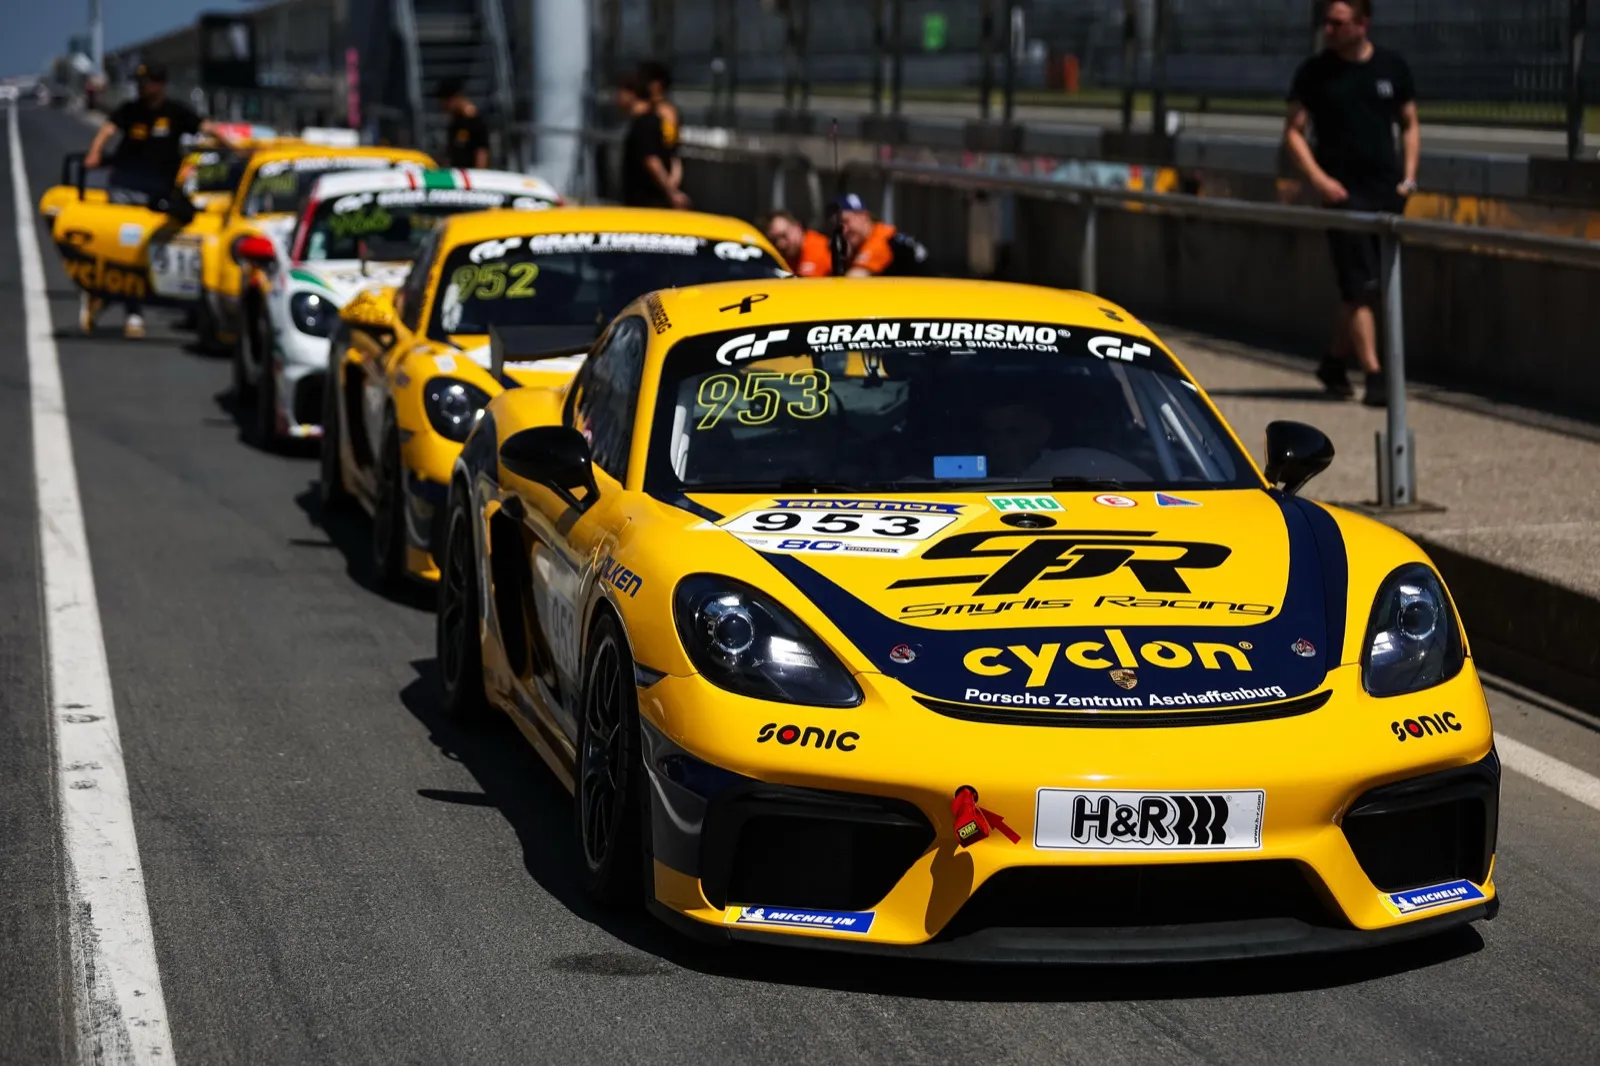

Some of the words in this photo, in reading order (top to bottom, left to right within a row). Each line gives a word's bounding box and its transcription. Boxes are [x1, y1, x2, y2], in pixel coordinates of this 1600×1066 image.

[529, 234, 595, 251] GRAN
[451, 261, 540, 302] 952
[806, 322, 901, 345] GRAN
[810, 342, 845, 353] THE
[848, 340, 893, 351] REAL
[894, 339, 962, 348] DRIVING
[965, 340, 1060, 354] SIMULATOR
[697, 368, 830, 430] 953
[786, 499, 948, 513] RAVENOL
[991, 497, 1058, 510] PRO
[752, 512, 921, 537] 953
[899, 597, 1074, 619] Smyrlis
[1093, 595, 1275, 616] Racing
[965, 688, 1050, 705] Porsche
[1054, 693, 1143, 707] Zentrum
[1149, 685, 1287, 707] Aschaffenburg
[958, 821, 977, 839] OMP
[1071, 794, 1176, 845] H&R
[1411, 886, 1468, 906] MICHELIN
[767, 911, 857, 926] MICHELIN
